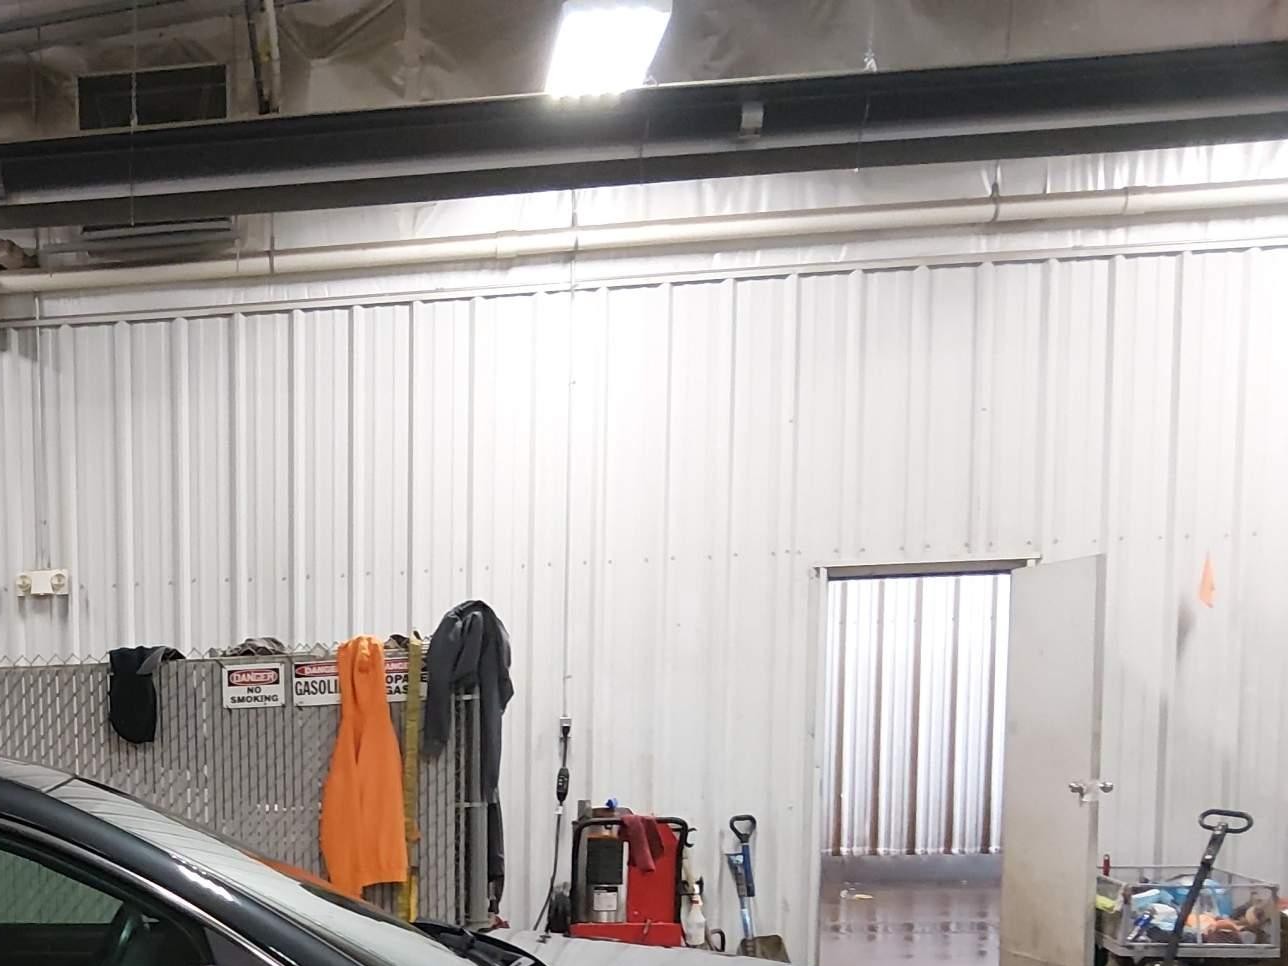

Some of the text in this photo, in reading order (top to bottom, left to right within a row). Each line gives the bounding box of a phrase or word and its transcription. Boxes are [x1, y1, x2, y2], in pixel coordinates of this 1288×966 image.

[384, 662, 409, 671] ANGE
[233, 672, 275, 682] DANGER
[247, 686, 262, 694] NO
[295, 679, 338, 696] GASOLI
[230, 695, 279, 704] SMOKING
